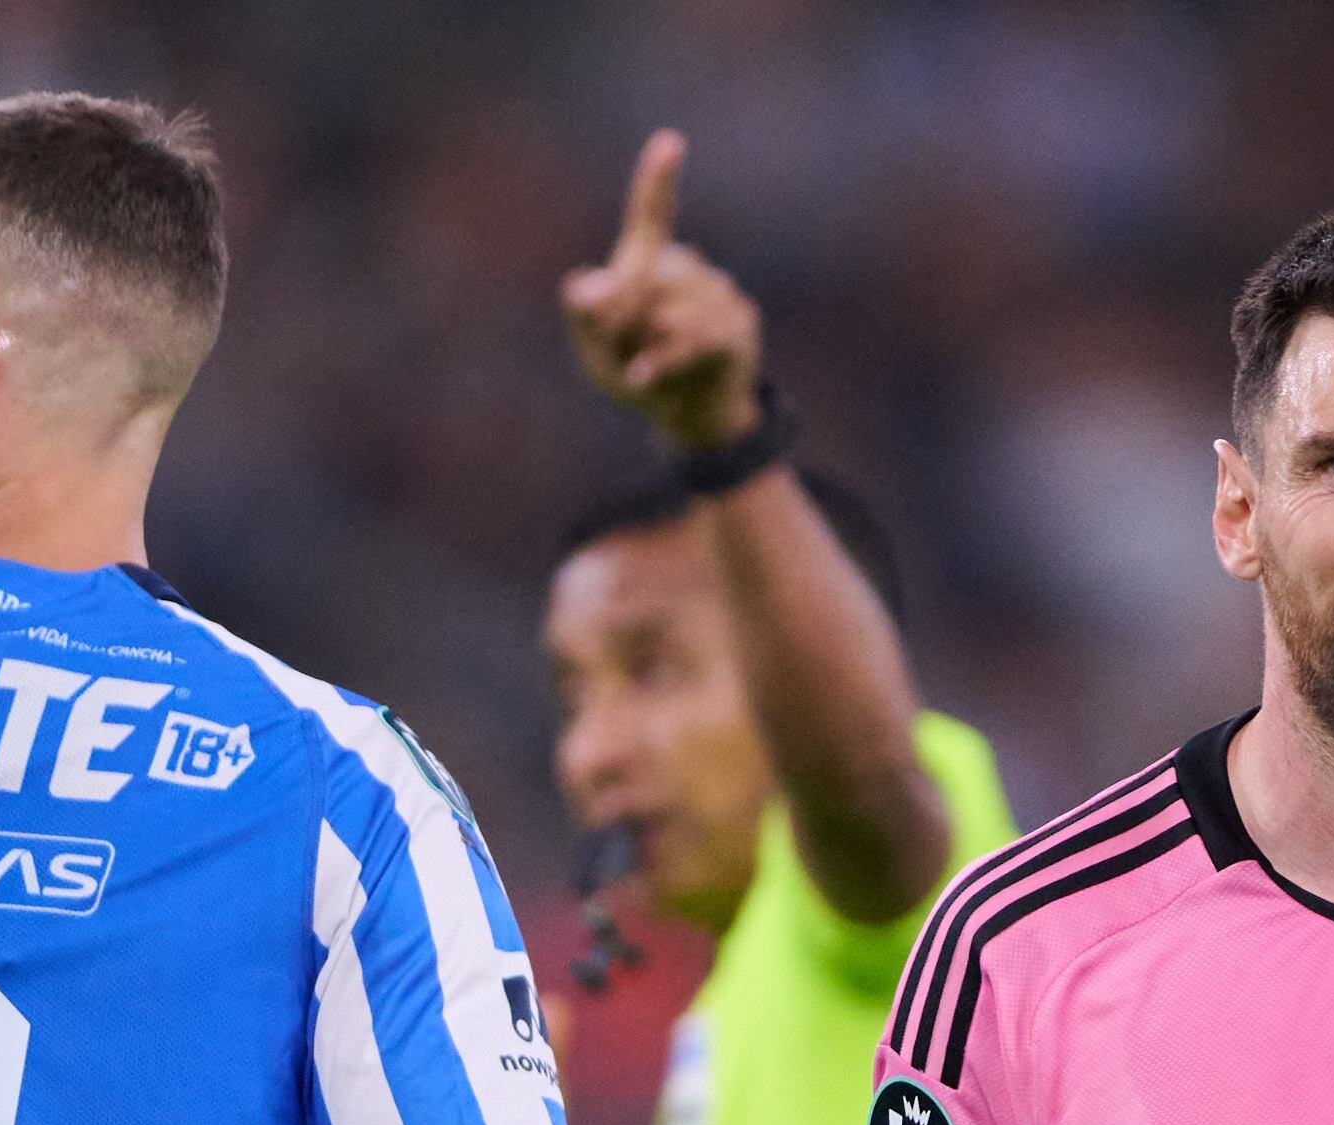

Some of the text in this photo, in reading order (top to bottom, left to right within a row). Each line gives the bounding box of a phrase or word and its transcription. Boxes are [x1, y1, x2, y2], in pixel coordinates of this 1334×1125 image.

[28, 626, 68, 648] VIDA
[105, 645, 173, 665] CANCHA
[166, 721, 252, 778] 18+
